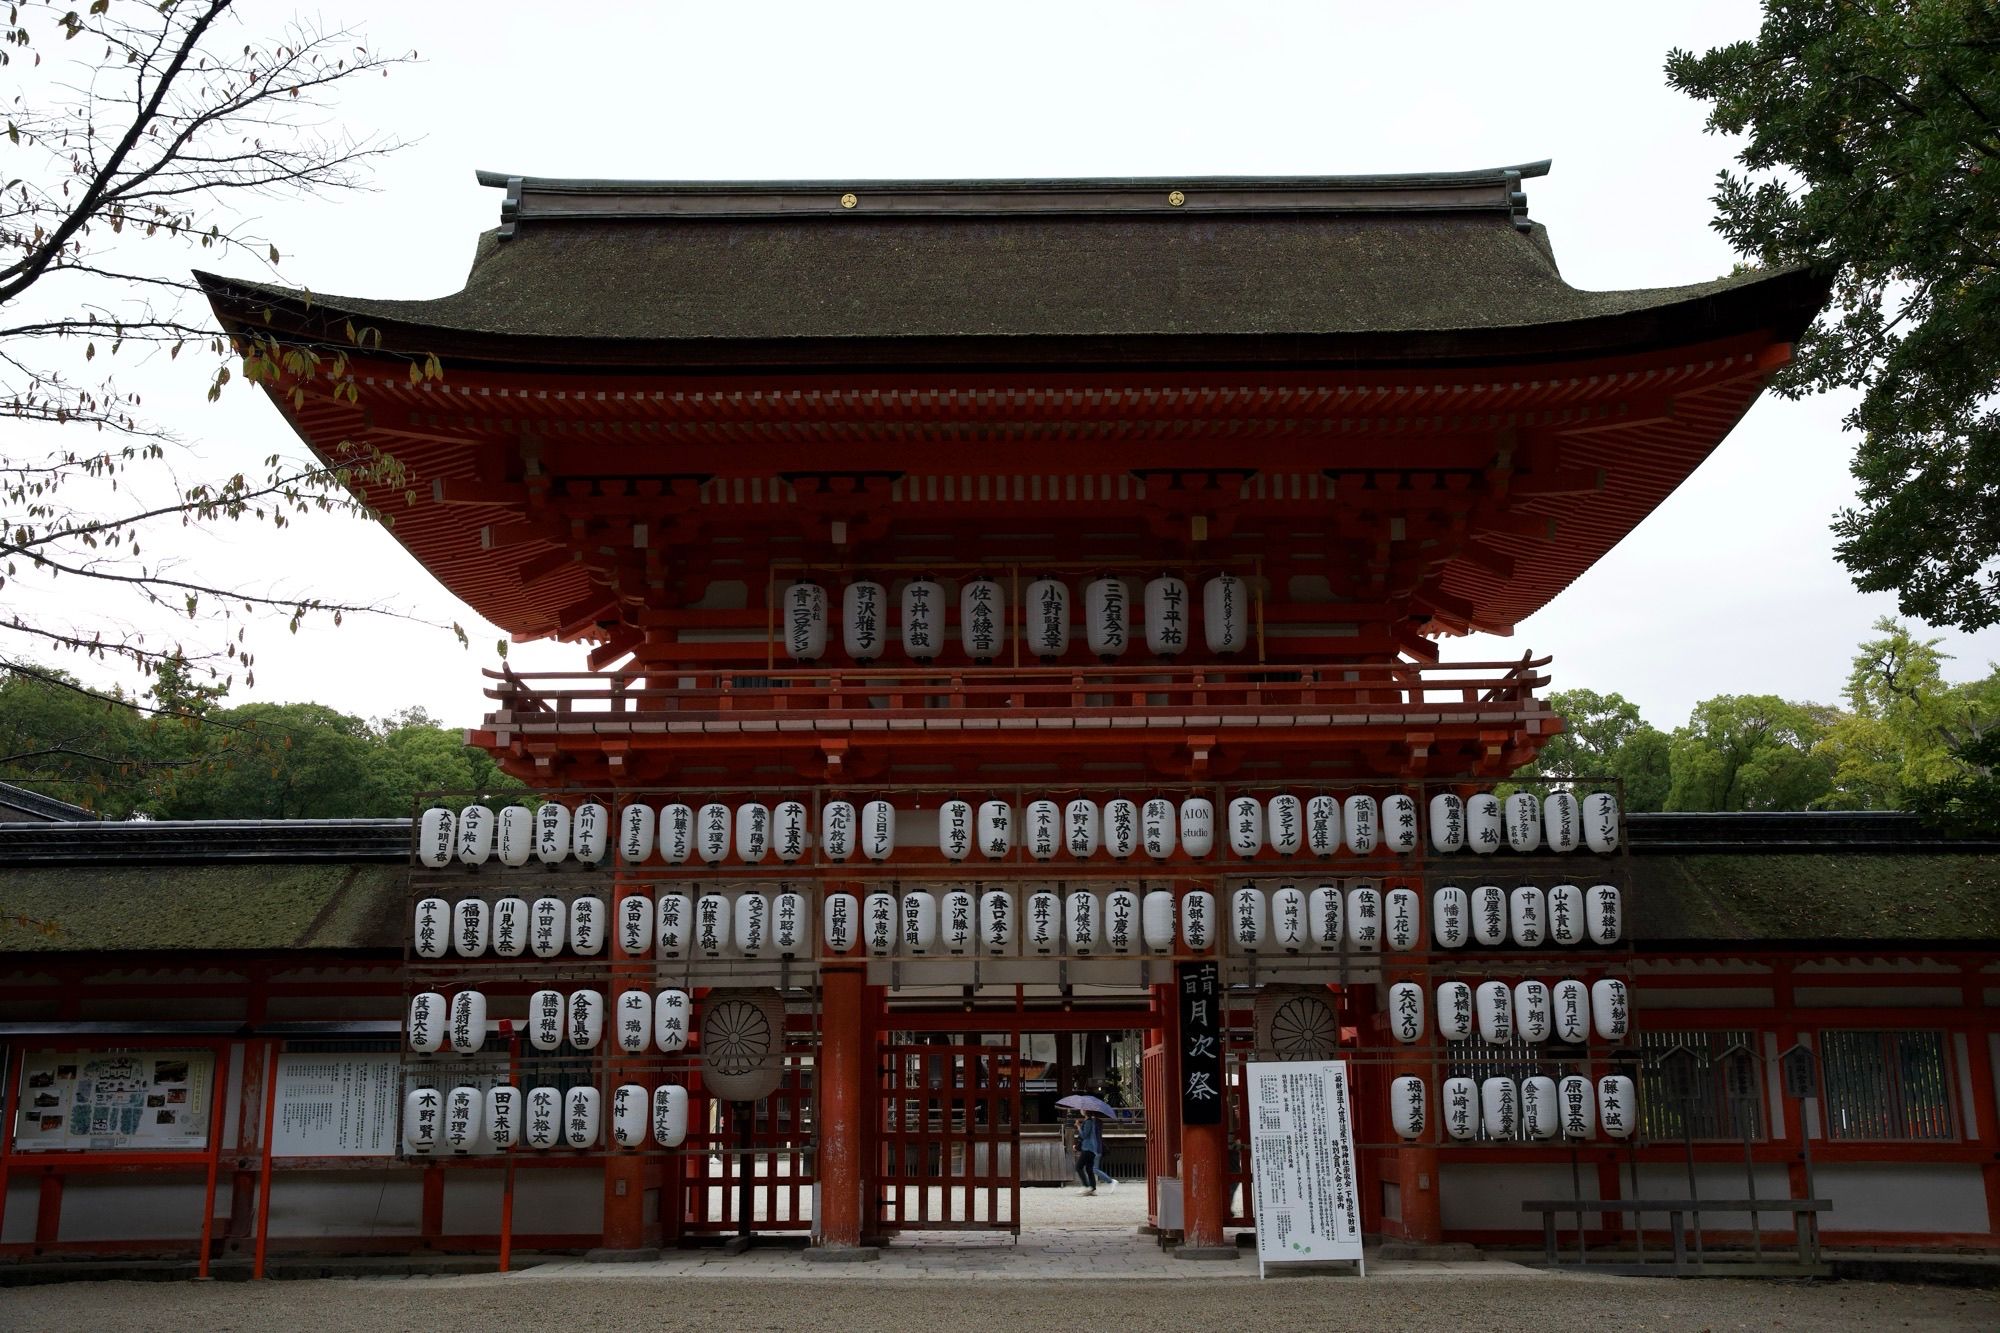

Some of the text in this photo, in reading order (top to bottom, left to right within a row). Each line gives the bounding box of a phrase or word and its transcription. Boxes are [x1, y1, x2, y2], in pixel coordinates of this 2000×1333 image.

[794, 588, 811, 651] 青二プロダクション
[812, 587, 821, 621] 株式会社
[856, 586, 876, 649] 野沢雅子
[910, 587, 930, 647] 中井和哉
[970, 585, 994, 649] 佐倉綾音
[1041, 585, 1062, 649] 小野賢章
[1103, 584, 1123, 646] 三石琴乃
[1161, 582, 1182, 644] 山下平祐
[434, 811, 452, 862] 大塚明日香
[462, 807, 482, 856] 谷口祐人
[503, 809, 512, 861] Chiaki
[541, 806, 558, 854] 福田まい
[628, 807, 641, 856] キセキミチコ
[749, 807, 766, 857] 無着陽平
[783, 805, 802, 855] 井上貴太
[829, 805, 846, 854] 文化放送
[875, 803, 887, 854] BS日テレ
[950, 804, 967, 854] 皆口裕子
[1072, 802, 1089, 852] 小野大輔
[1114, 803, 1131, 852] 沢城みゆき
[1147, 802, 1160, 853] 第一興商
[1184, 809, 1209, 820] AION
[1184, 829, 1208, 837] studio
[1238, 801, 1256, 848] 京まふ
[1312, 799, 1329, 849] 小丸屋住井
[1355, 799, 1372, 850] 祇園辻利
[1396, 798, 1415, 846] 松栄堂
[1444, 796, 1461, 844] 鶴屋吉信
[1480, 802, 1499, 844] 老松
[1599, 796, 1615, 846] ナターシャ
[420, 901, 437, 953] 平手俊夫
[498, 901, 515, 952] 川見茉奈
[537, 901, 553, 953] 井田洋平
[576, 901, 593, 949] 磯部宏之
[626, 900, 643, 948] 安田繁之
[700, 899, 718, 950] 加藤夏樹
[831, 898, 847, 946] 日比野剛士
[872, 897, 890, 947] 不破恵悟
[905, 897, 920, 945] 池田克明
[952, 896, 968, 946] 池沢勝斗
[1033, 896, 1050, 945] 藤井フミヤ
[1075, 894, 1092, 943] 竹内健次郎
[1112, 895, 1131, 946] 丸山慶将
[1188, 895, 1205, 946] 服部泰高
[1239, 891, 1257, 943] 木村英輝
[1393, 894, 1409, 945] 野上花音
[1484, 889, 1501, 937] 照屋秀吾
[1521, 892, 1539, 942] 中馬一登
[1554, 889, 1572, 940] 山本貴紀
[1598, 889, 1616, 940] 加藤綾佳
[454, 993, 472, 1048] 美濃羽拓哉
[540, 994, 559, 1043] 藤田雅也
[1399, 988, 1419, 1039] 矢代えり
[1454, 985, 1470, 1034] 高橋知之
[1527, 985, 1545, 1035] 田中翔子
[1562, 986, 1582, 1038] 岩月正人
[1185, 999, 1219, 1101] 月次祭
[493, 1092, 512, 1143] 田口未羽
[532, 1093, 551, 1144] 秋山裕太
[655, 1090, 670, 1142] 藤野文彦
[1407, 1080, 1423, 1132] 堀井美香
[1497, 1082, 1514, 1135] 三谷佳奈美
[1523, 1081, 1543, 1135] 金子明日美
[1564, 1080, 1586, 1131] 原田里奈
[1603, 1080, 1623, 1131] 藤本誠一
